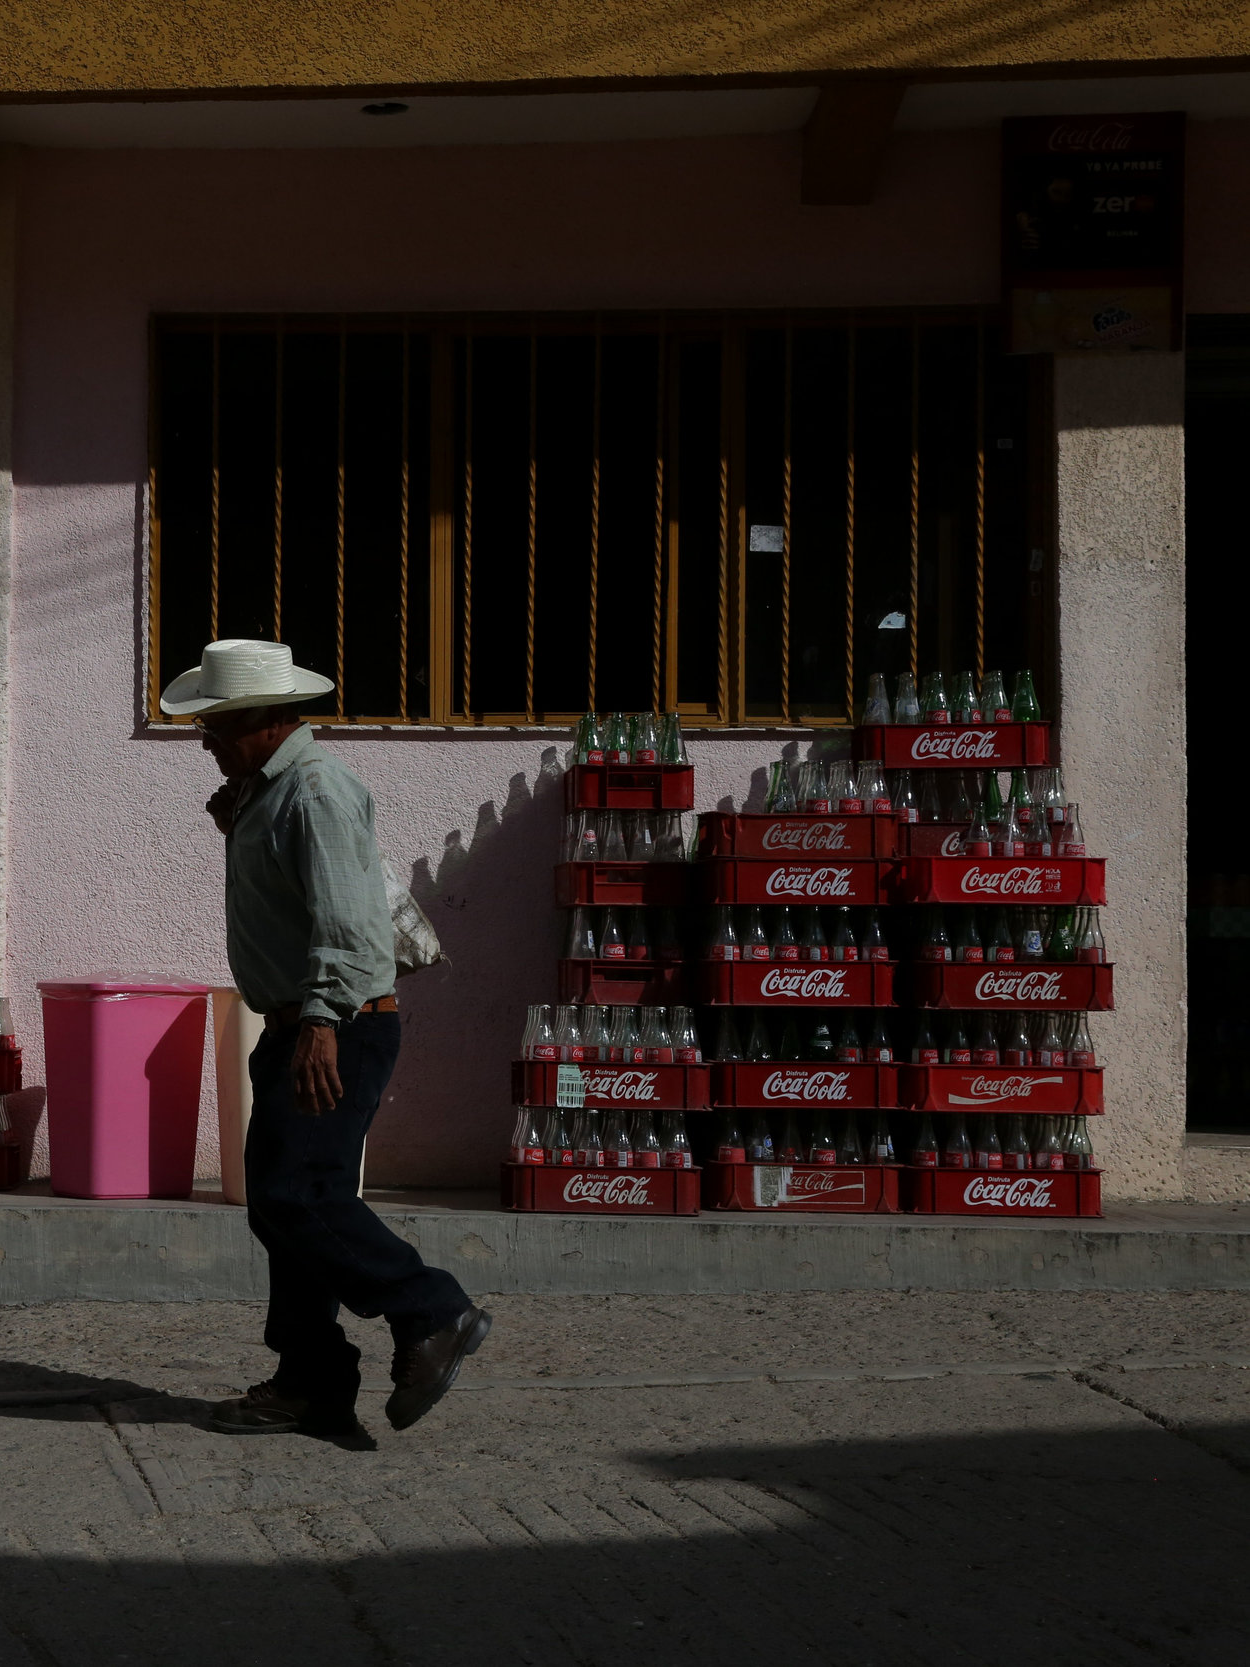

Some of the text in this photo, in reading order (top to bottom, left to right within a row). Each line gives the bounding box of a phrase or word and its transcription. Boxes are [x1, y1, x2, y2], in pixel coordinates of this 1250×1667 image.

[911, 730, 998, 760] Coca-Cola
[762, 822, 848, 850] Coca-Cola
[766, 867, 853, 896] Coca-Cola
[961, 866, 1046, 894] Coca-Cola
[761, 968, 847, 997] Coca-Cola
[975, 971, 1063, 1000] Coca-Cola
[762, 1071, 851, 1100] Coca-Cola
[970, 1075, 1034, 1097] Coca-Cola
[563, 1174, 651, 1205] Coca-Cola
[963, 1176, 1054, 1207] Coca-Cola
